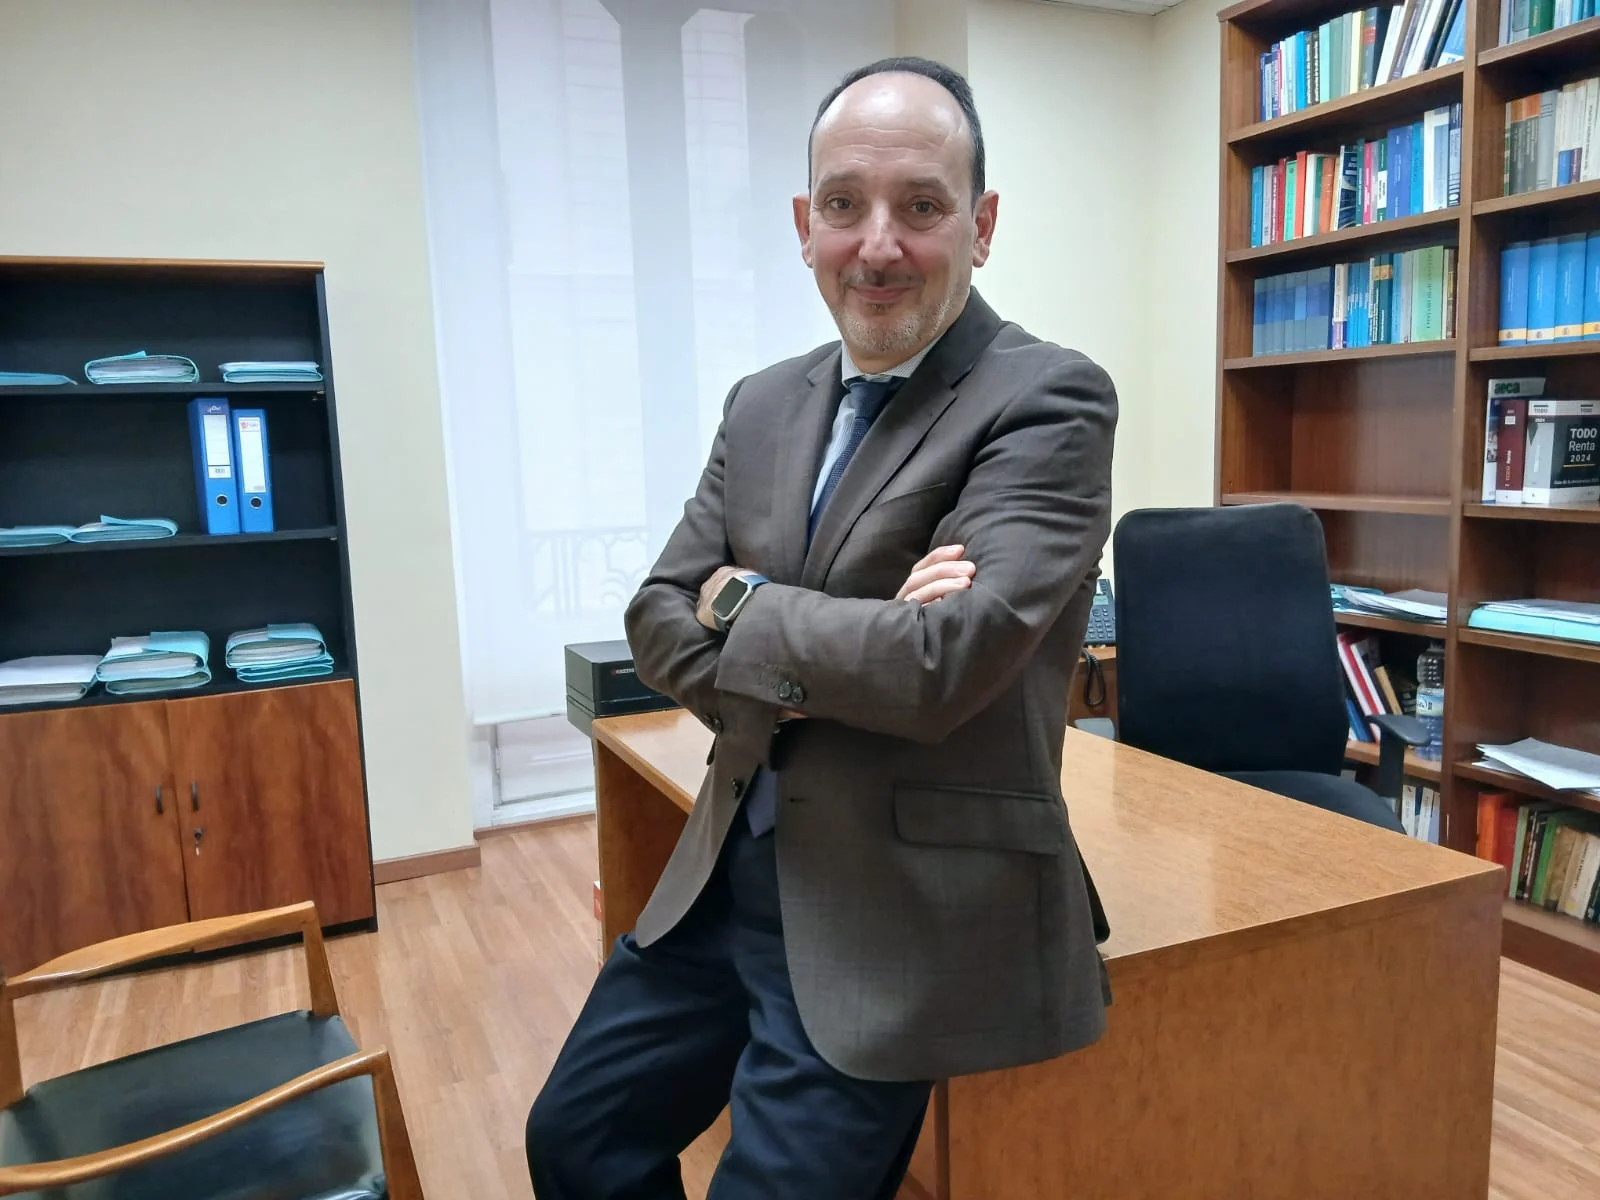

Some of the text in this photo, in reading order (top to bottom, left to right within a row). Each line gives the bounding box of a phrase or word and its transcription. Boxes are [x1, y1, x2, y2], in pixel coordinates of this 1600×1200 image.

[1494, 383, 1520, 394] aeca
[1570, 428, 1597, 439] TODO
[1568, 441, 1595, 452] Renta
[1570, 453, 1591, 463] 2024
